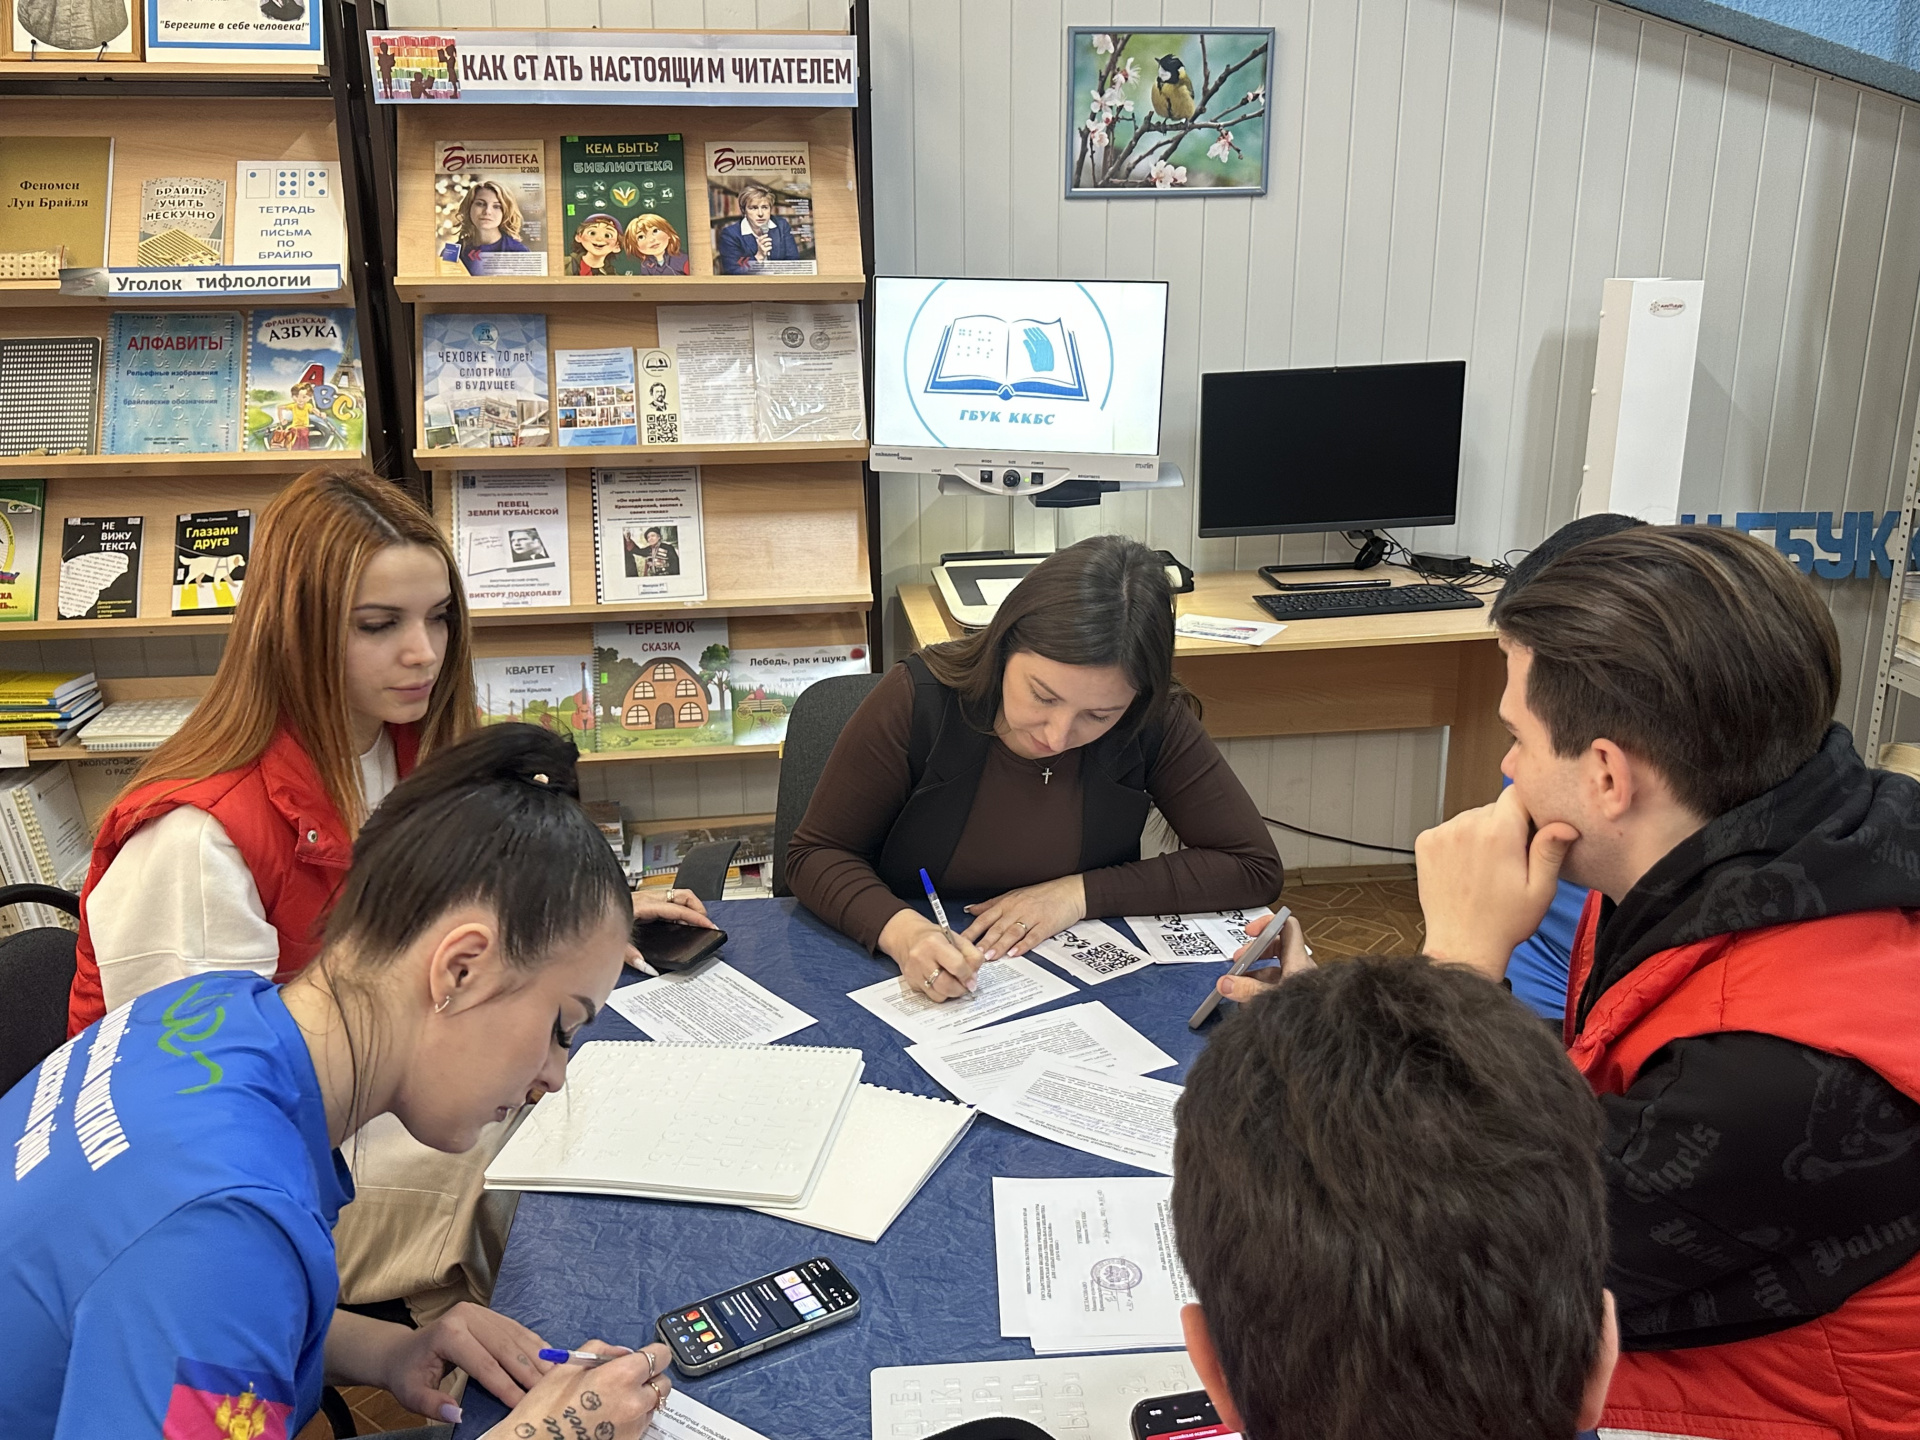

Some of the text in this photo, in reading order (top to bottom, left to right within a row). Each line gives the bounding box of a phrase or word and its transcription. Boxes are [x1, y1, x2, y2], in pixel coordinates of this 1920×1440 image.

[160, 20, 216, 31] "Берегите
[227, 21, 250, 30] себе
[253, 22, 309, 31] человека!"
[462, 54, 851, 88] КАК СТАТЬ НАСТОЯЩИМ ЧИТАТЕЛЕМ
[585, 142, 660, 154] КЕМ БЫТЬ?
[443, 146, 539, 172] БИБЛИОТЕКА
[714, 148, 806, 174] БИБЛИОТЕКА
[573, 160, 673, 174] БИБЛИОТЕКА
[20, 180, 80, 190] Феномен
[156, 186, 208, 196] БРАЙЛЬ
[7, 197, 89, 210] Луи Брайля
[159, 199, 204, 209] УЧИТЬ
[146, 211, 216, 221] НЕСКУЧНО
[259, 206, 316, 215] ТЕТРАДЬ
[273, 218, 299, 227] ДЛЯ
[260, 229, 312, 237] ПИСЬМА
[277, 240, 295, 248] ПО
[258, 250, 313, 260] БРАЙЛЮ
[116, 273, 311, 293] Уголок тифлологии
[264, 316, 327, 329] ФРАНЦУЗСКАЯ
[268, 325, 338, 342] АЗБУКА
[127, 336, 223, 351] АЛФАВИТЫ
[438, 351, 487, 363] ЧЕХОВКЕ
[497, 351, 510, 362] 70
[513, 351, 534, 362] лет!
[126, 369, 219, 377] Рельефные изображения
[459, 367, 512, 378] СМОТРИМ
[455, 379, 516, 391] В БУДУЩЕЕ
[172, 398, 218, 406] обозначения
[959, 409, 1056, 425] ГБУК ККБС
[497, 500, 530, 508] ПЕВЕЦ
[467, 507, 559, 517] ЗЕМЛИ КУБАНСКОЙ
[101, 521, 116, 530] НЕ
[101, 531, 132, 541] ВИЖУ
[185, 526, 239, 539] Глазами
[100, 541, 137, 551] ТЕКСТА
[193, 537, 230, 551] друга
[469, 590, 562, 599] ВИКТОРУ ПОДКОПАЕВУ
[625, 620, 696, 636] ТЕРЕМОК
[641, 641, 681, 652] СКАЗКА
[749, 658, 791, 667] Лебедь,
[793, 657, 811, 666] рак
[821, 655, 847, 664] щука
[505, 665, 555, 675] КВАРТЕТ
